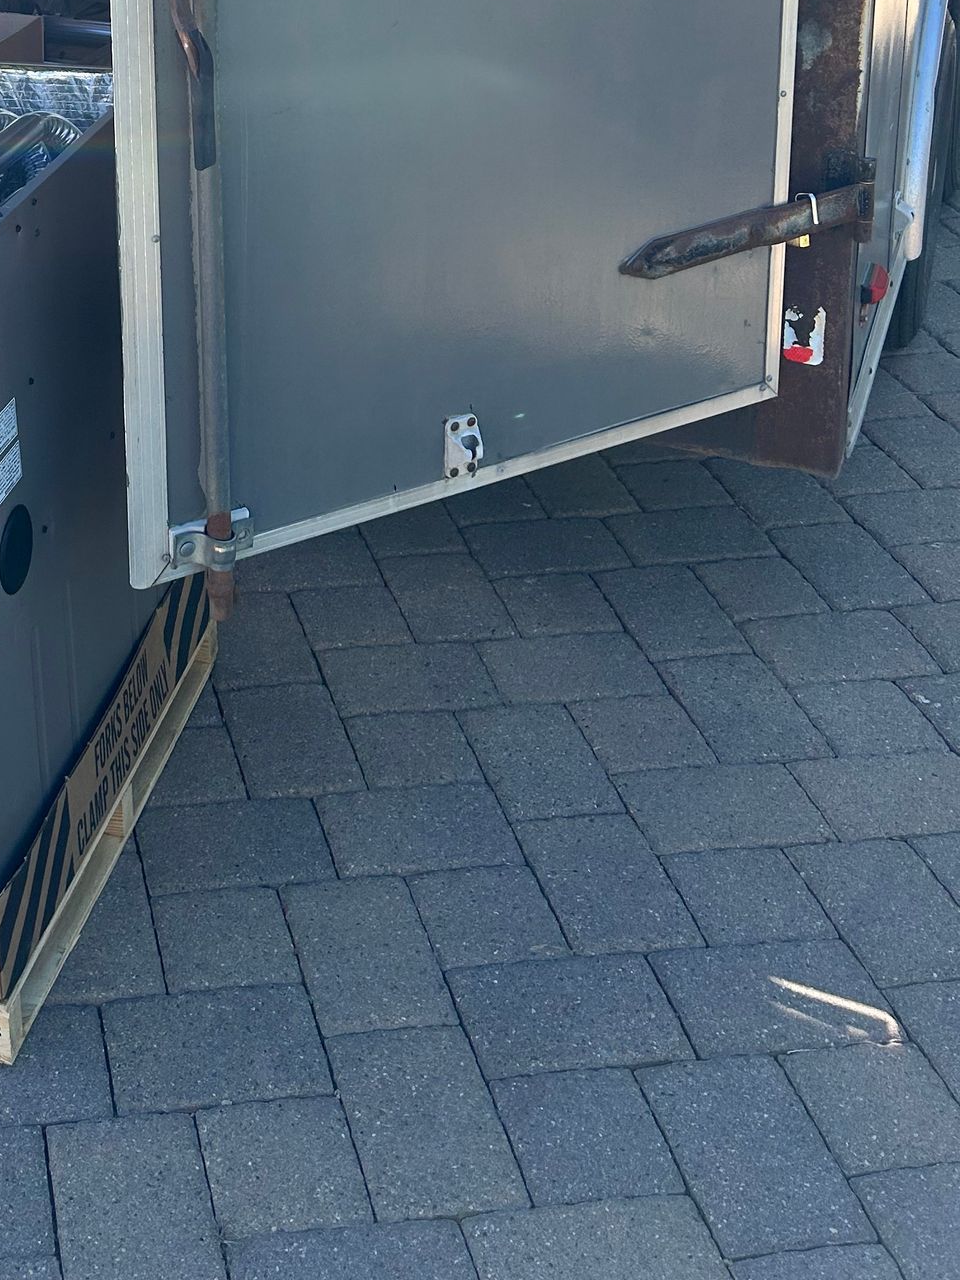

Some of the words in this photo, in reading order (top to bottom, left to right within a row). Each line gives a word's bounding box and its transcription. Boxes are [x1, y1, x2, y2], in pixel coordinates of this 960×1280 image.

[77, 777, 109, 856] CLAMP
[109, 736, 131, 796] THIS
[131, 698, 151, 757] SIDE
[150, 661, 170, 720] ONLY
[93, 703, 123, 778] FORKS
[123, 650, 150, 723] BELOW
